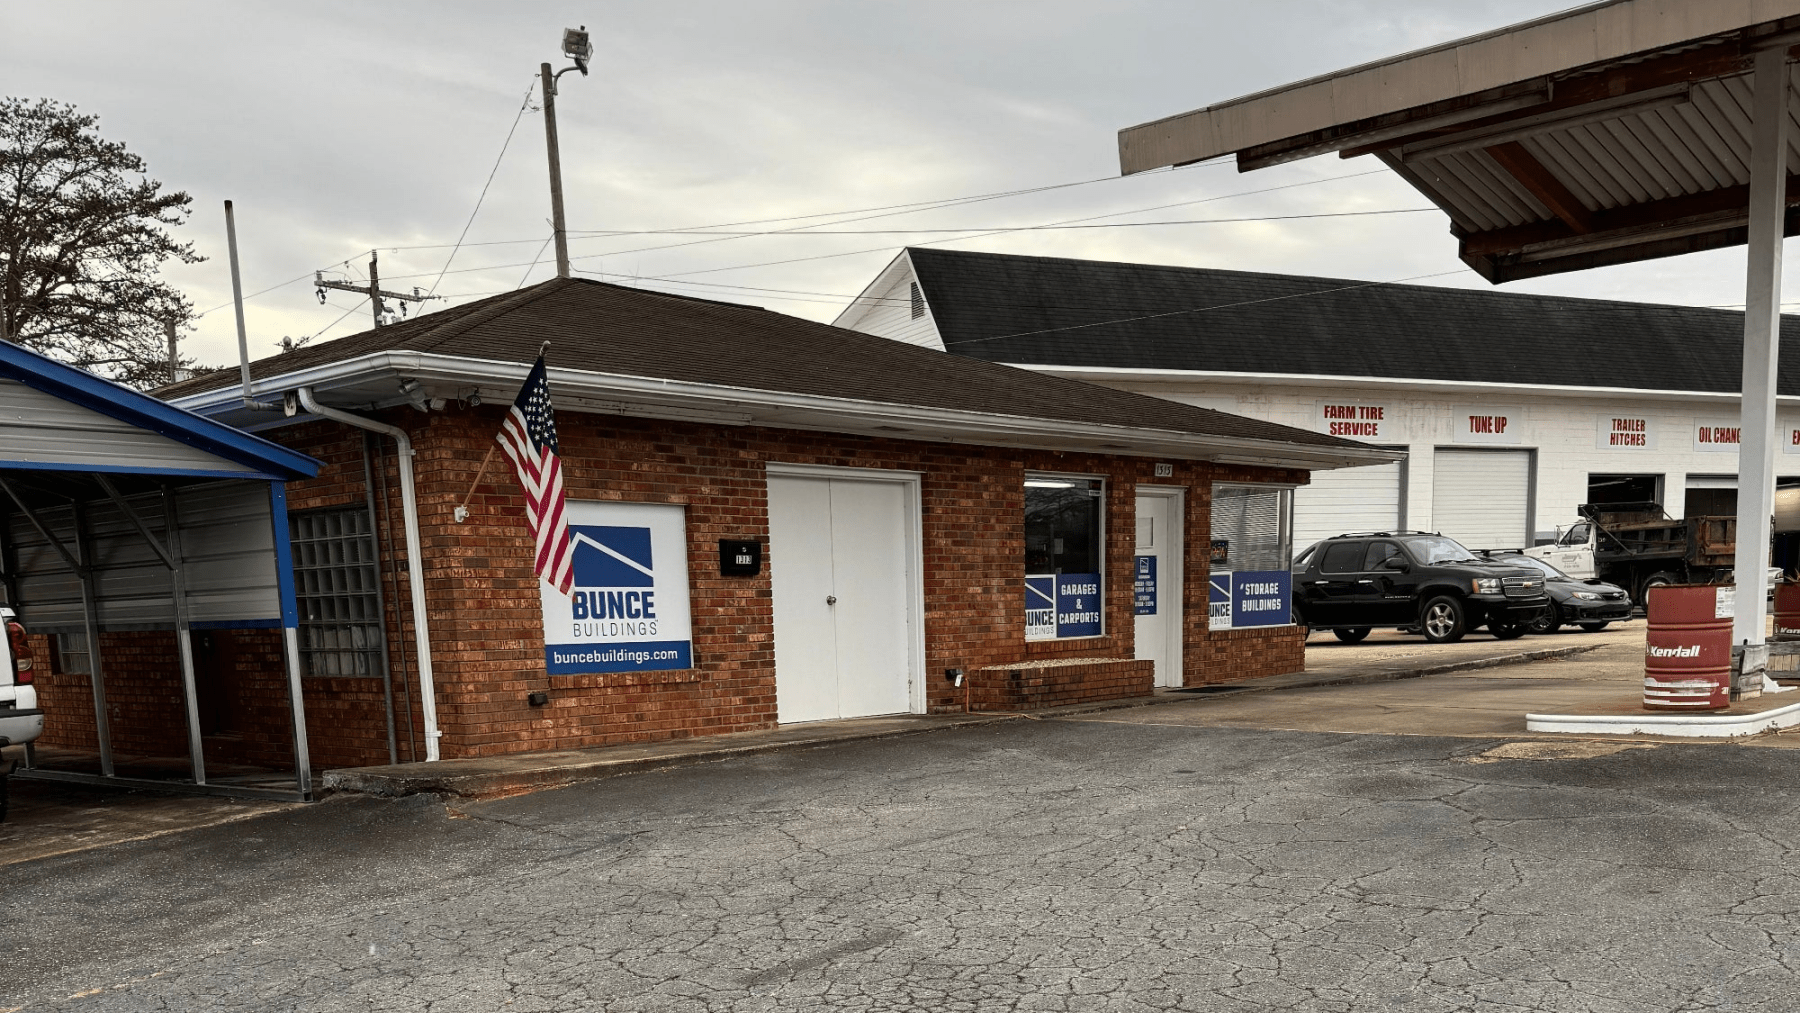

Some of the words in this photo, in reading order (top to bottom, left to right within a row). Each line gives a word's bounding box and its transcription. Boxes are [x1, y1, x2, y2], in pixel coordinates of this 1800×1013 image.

[1324, 405, 1356, 419] FARM
[1359, 406, 1384, 420] TIRE
[1329, 421, 1378, 436] SERVICE
[1469, 415, 1492, 433] TUNE
[1494, 416, 1507, 433] UP
[1612, 418, 1646, 432] TRAILER
[1610, 432, 1646, 446] HITCHES
[1699, 426, 1712, 443] OIL
[1713, 427, 1741, 443] CHANG
[1061, 583, 1097, 596] GARAGES
[1245, 582, 1279, 596] STORAGE
[572, 591, 656, 620] BUNCE
[1075, 598, 1083, 610] &
[1210, 603, 1231, 617] UNCE
[1241, 598, 1282, 612] BUILDINGS
[1025, 610, 1054, 627] UNCE
[1058, 611, 1099, 625] CARPORTS
[573, 621, 657, 638] BUILDINGS
[1025, 626, 1055, 636] UILDINGS
[553, 649, 678, 665] buncebuildings.com
[1650, 644, 1701, 658] Kendall
